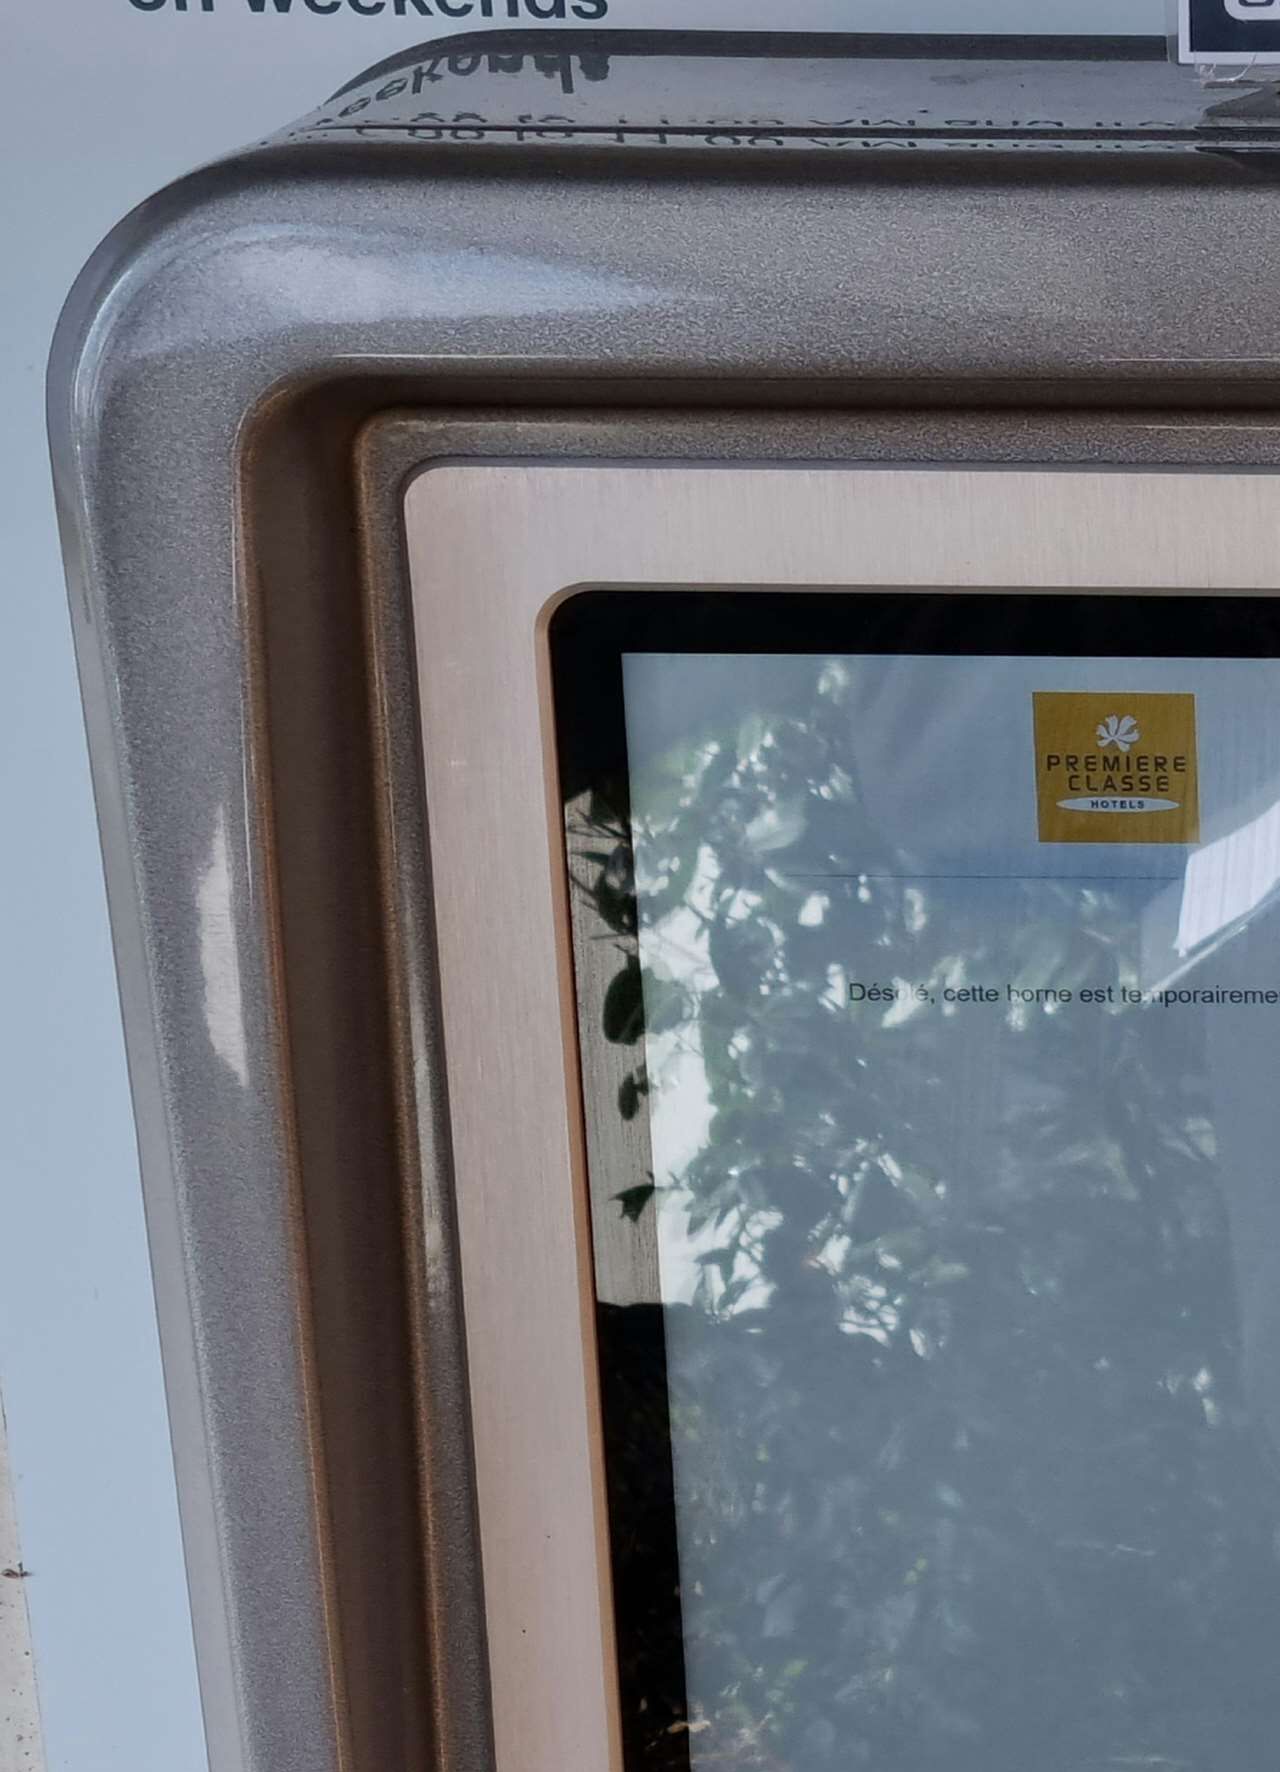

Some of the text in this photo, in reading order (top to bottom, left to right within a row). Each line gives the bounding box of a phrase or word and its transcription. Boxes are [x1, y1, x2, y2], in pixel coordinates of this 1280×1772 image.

[1046, 755, 1186, 773] PREMIERE
[1067, 774, 1169, 792] CLASSE
[1090, 799, 1145, 810] HOTELS
[943, 983, 999, 1002] cette
[1079, 986, 1113, 1003] est
